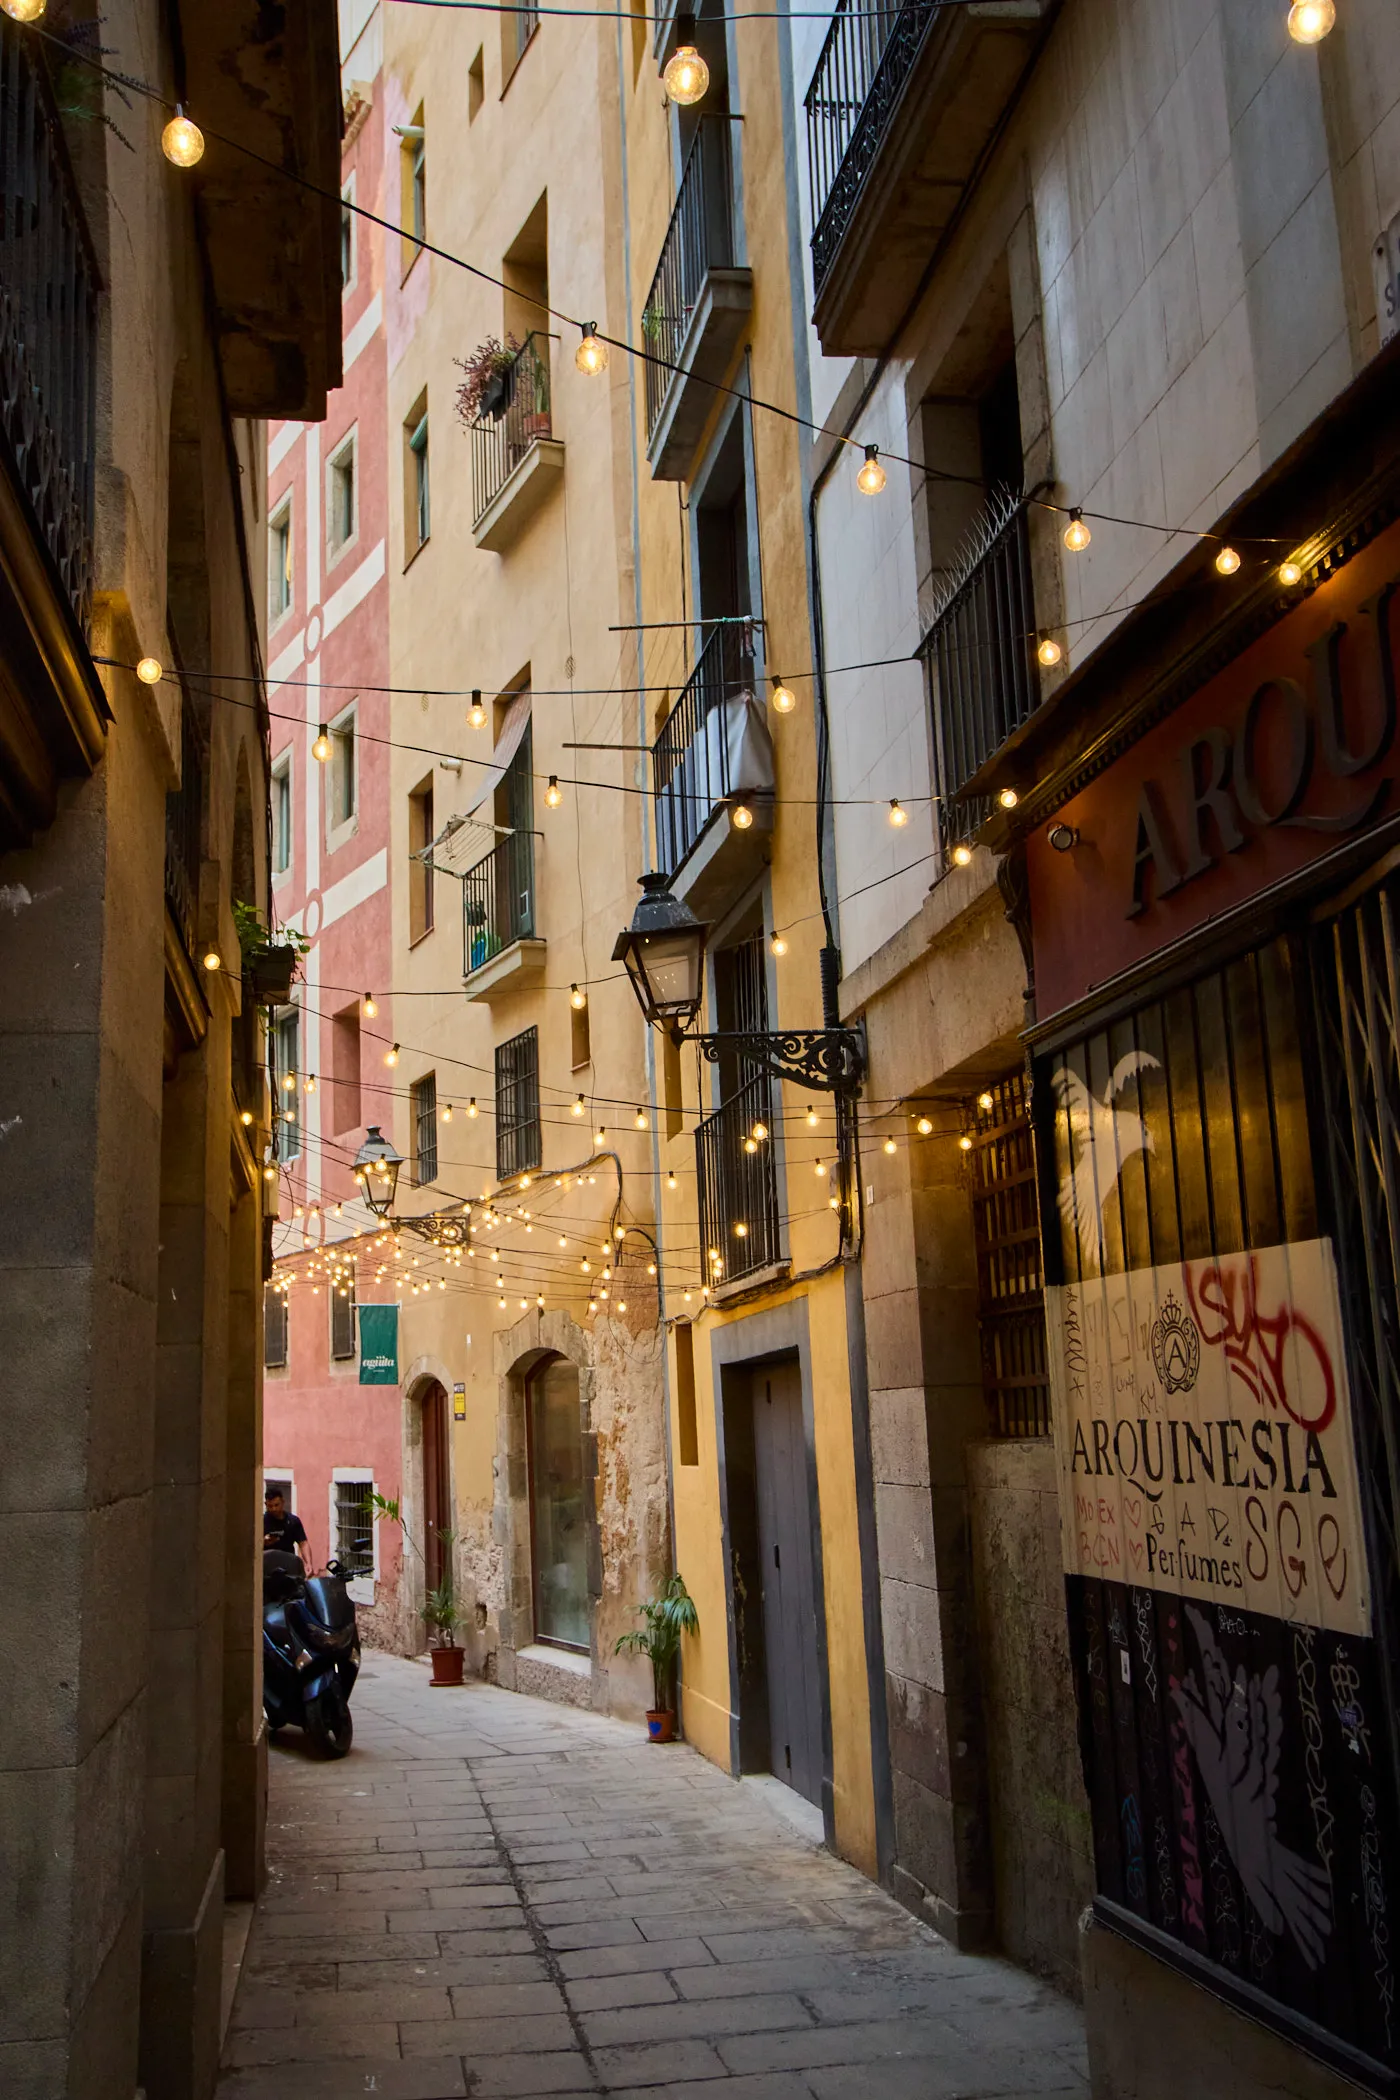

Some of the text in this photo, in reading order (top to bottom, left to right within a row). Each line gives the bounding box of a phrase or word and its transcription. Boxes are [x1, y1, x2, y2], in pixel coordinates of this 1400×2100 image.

[1125, 581, 1400, 920] ARQU
[1071, 1418, 1338, 1502] ARQUINESIA
[1146, 1531, 1243, 1588] Perfumes
